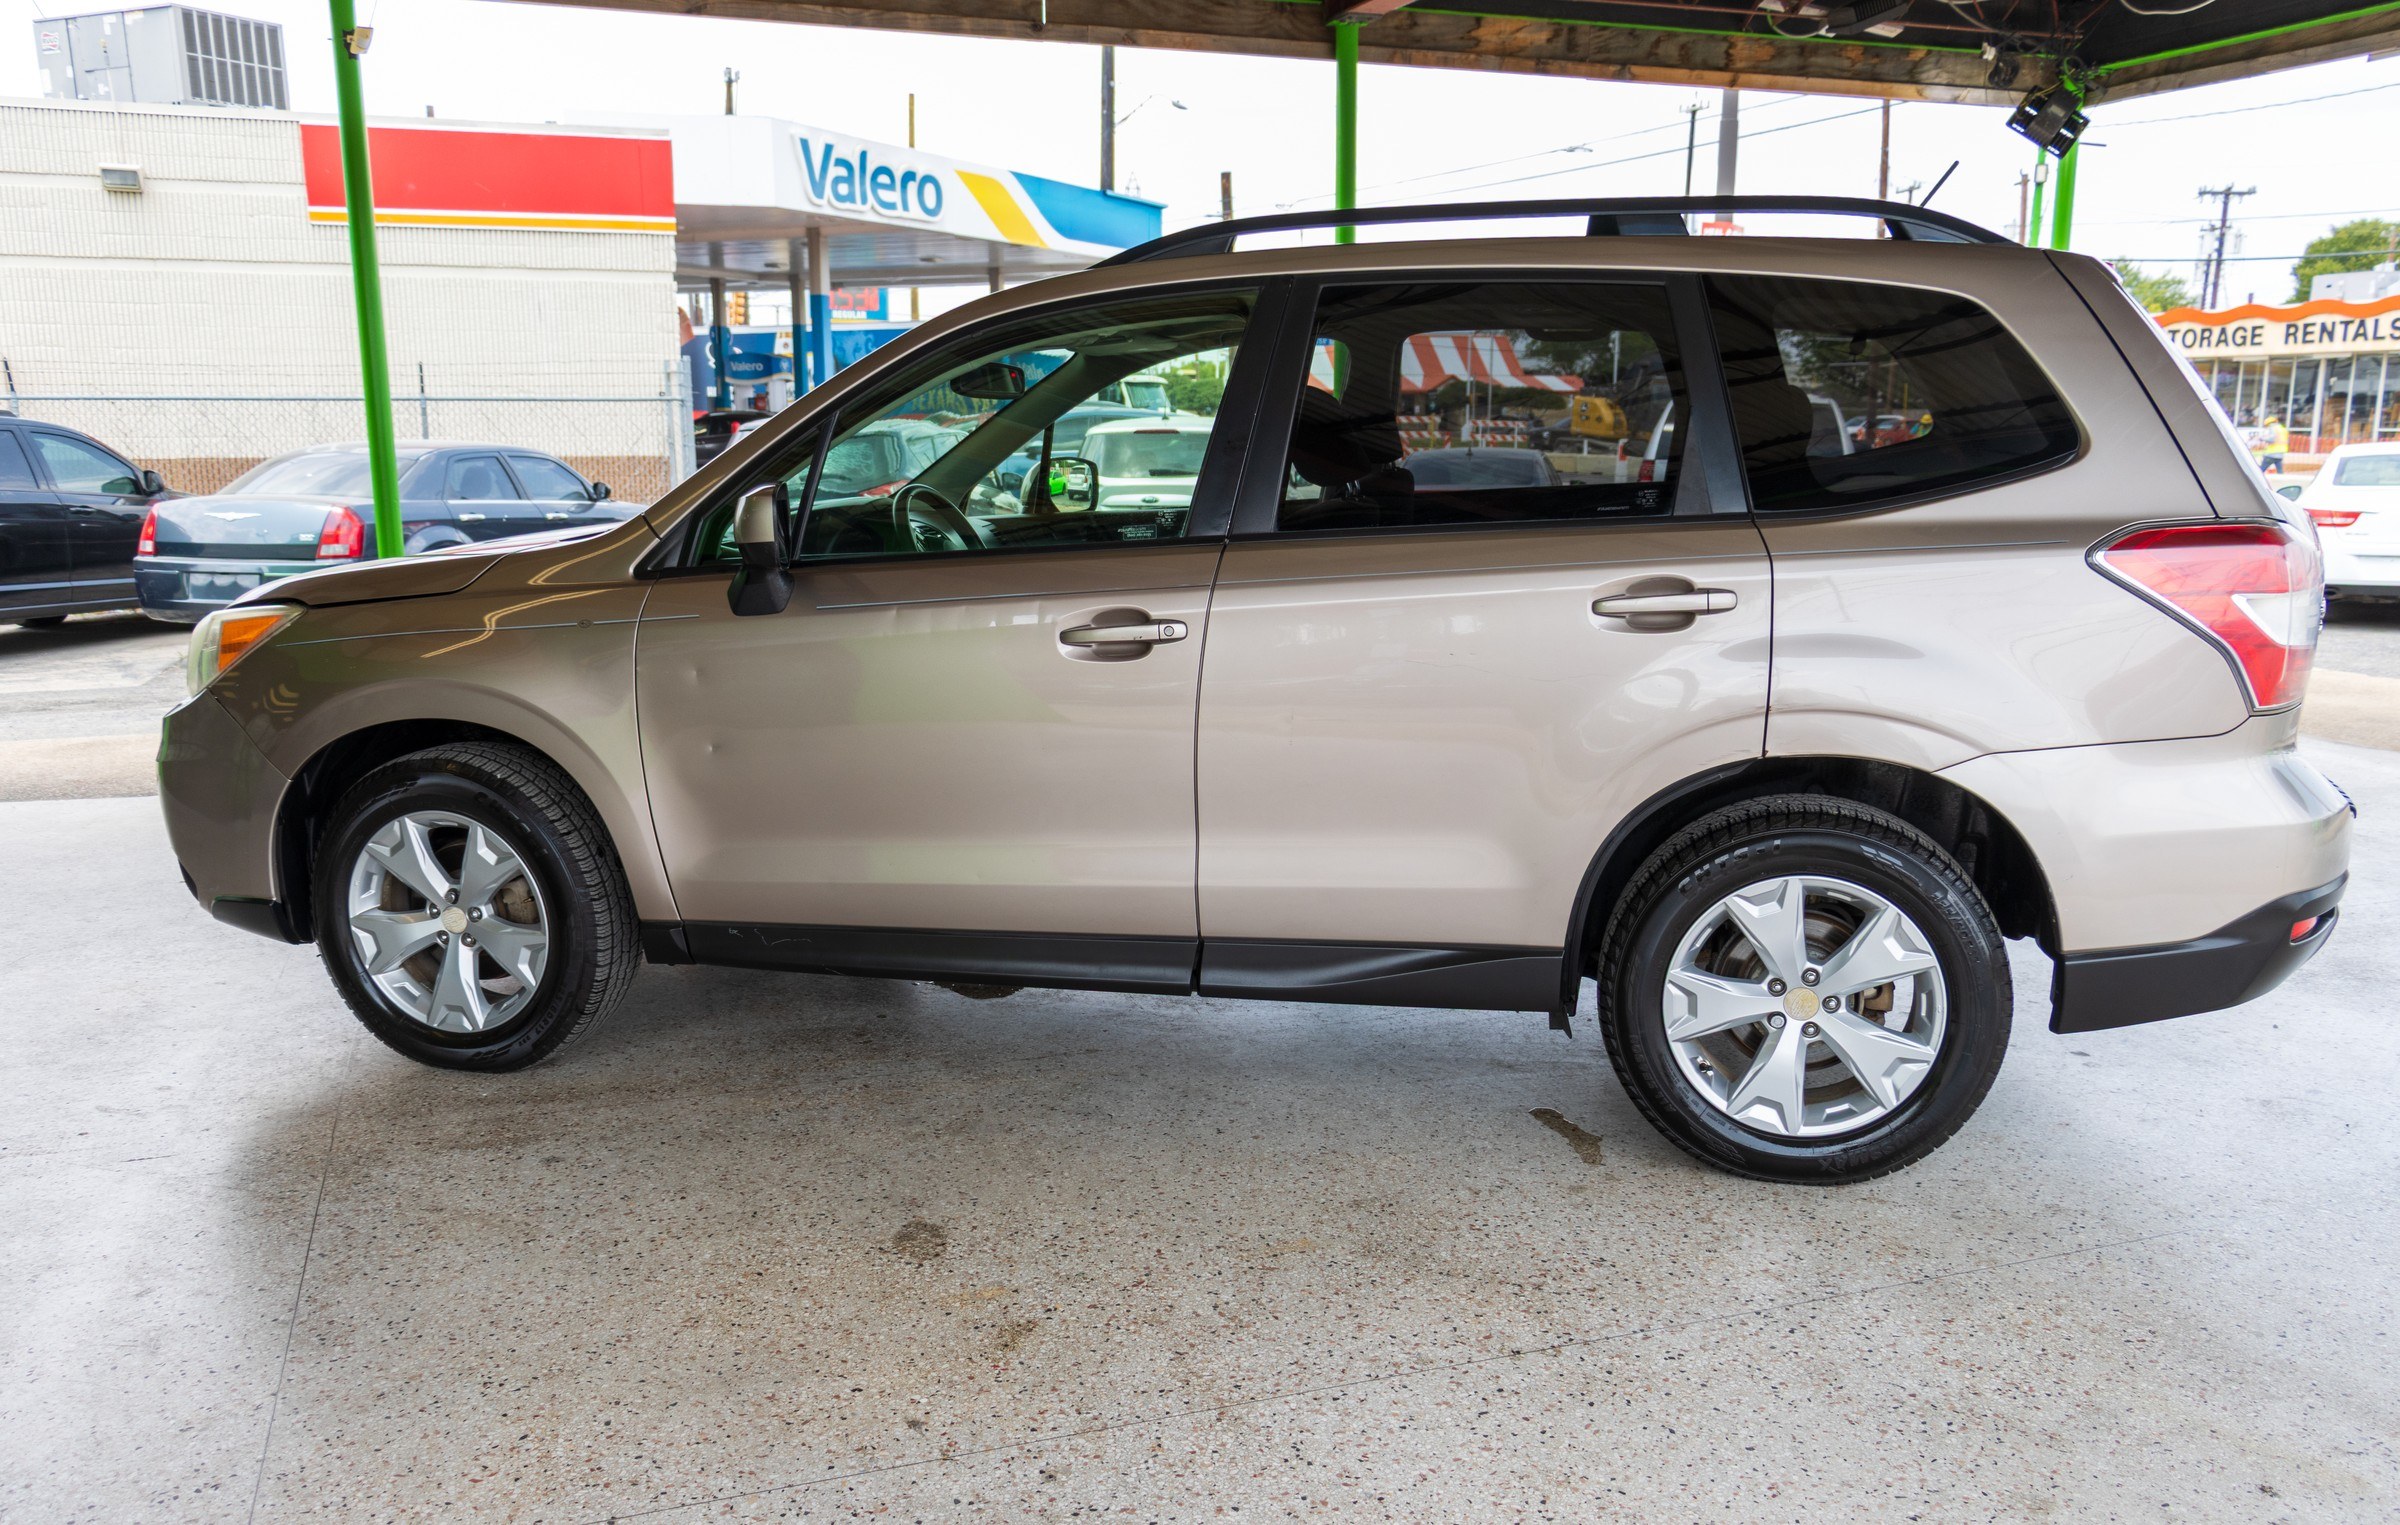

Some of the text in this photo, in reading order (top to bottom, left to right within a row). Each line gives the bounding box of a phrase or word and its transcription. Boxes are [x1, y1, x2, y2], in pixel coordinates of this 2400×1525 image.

[799, 137, 943, 217] Valero
[2284, 317, 2400, 345] RENTALS
[730, 361, 764, 371] Valero
